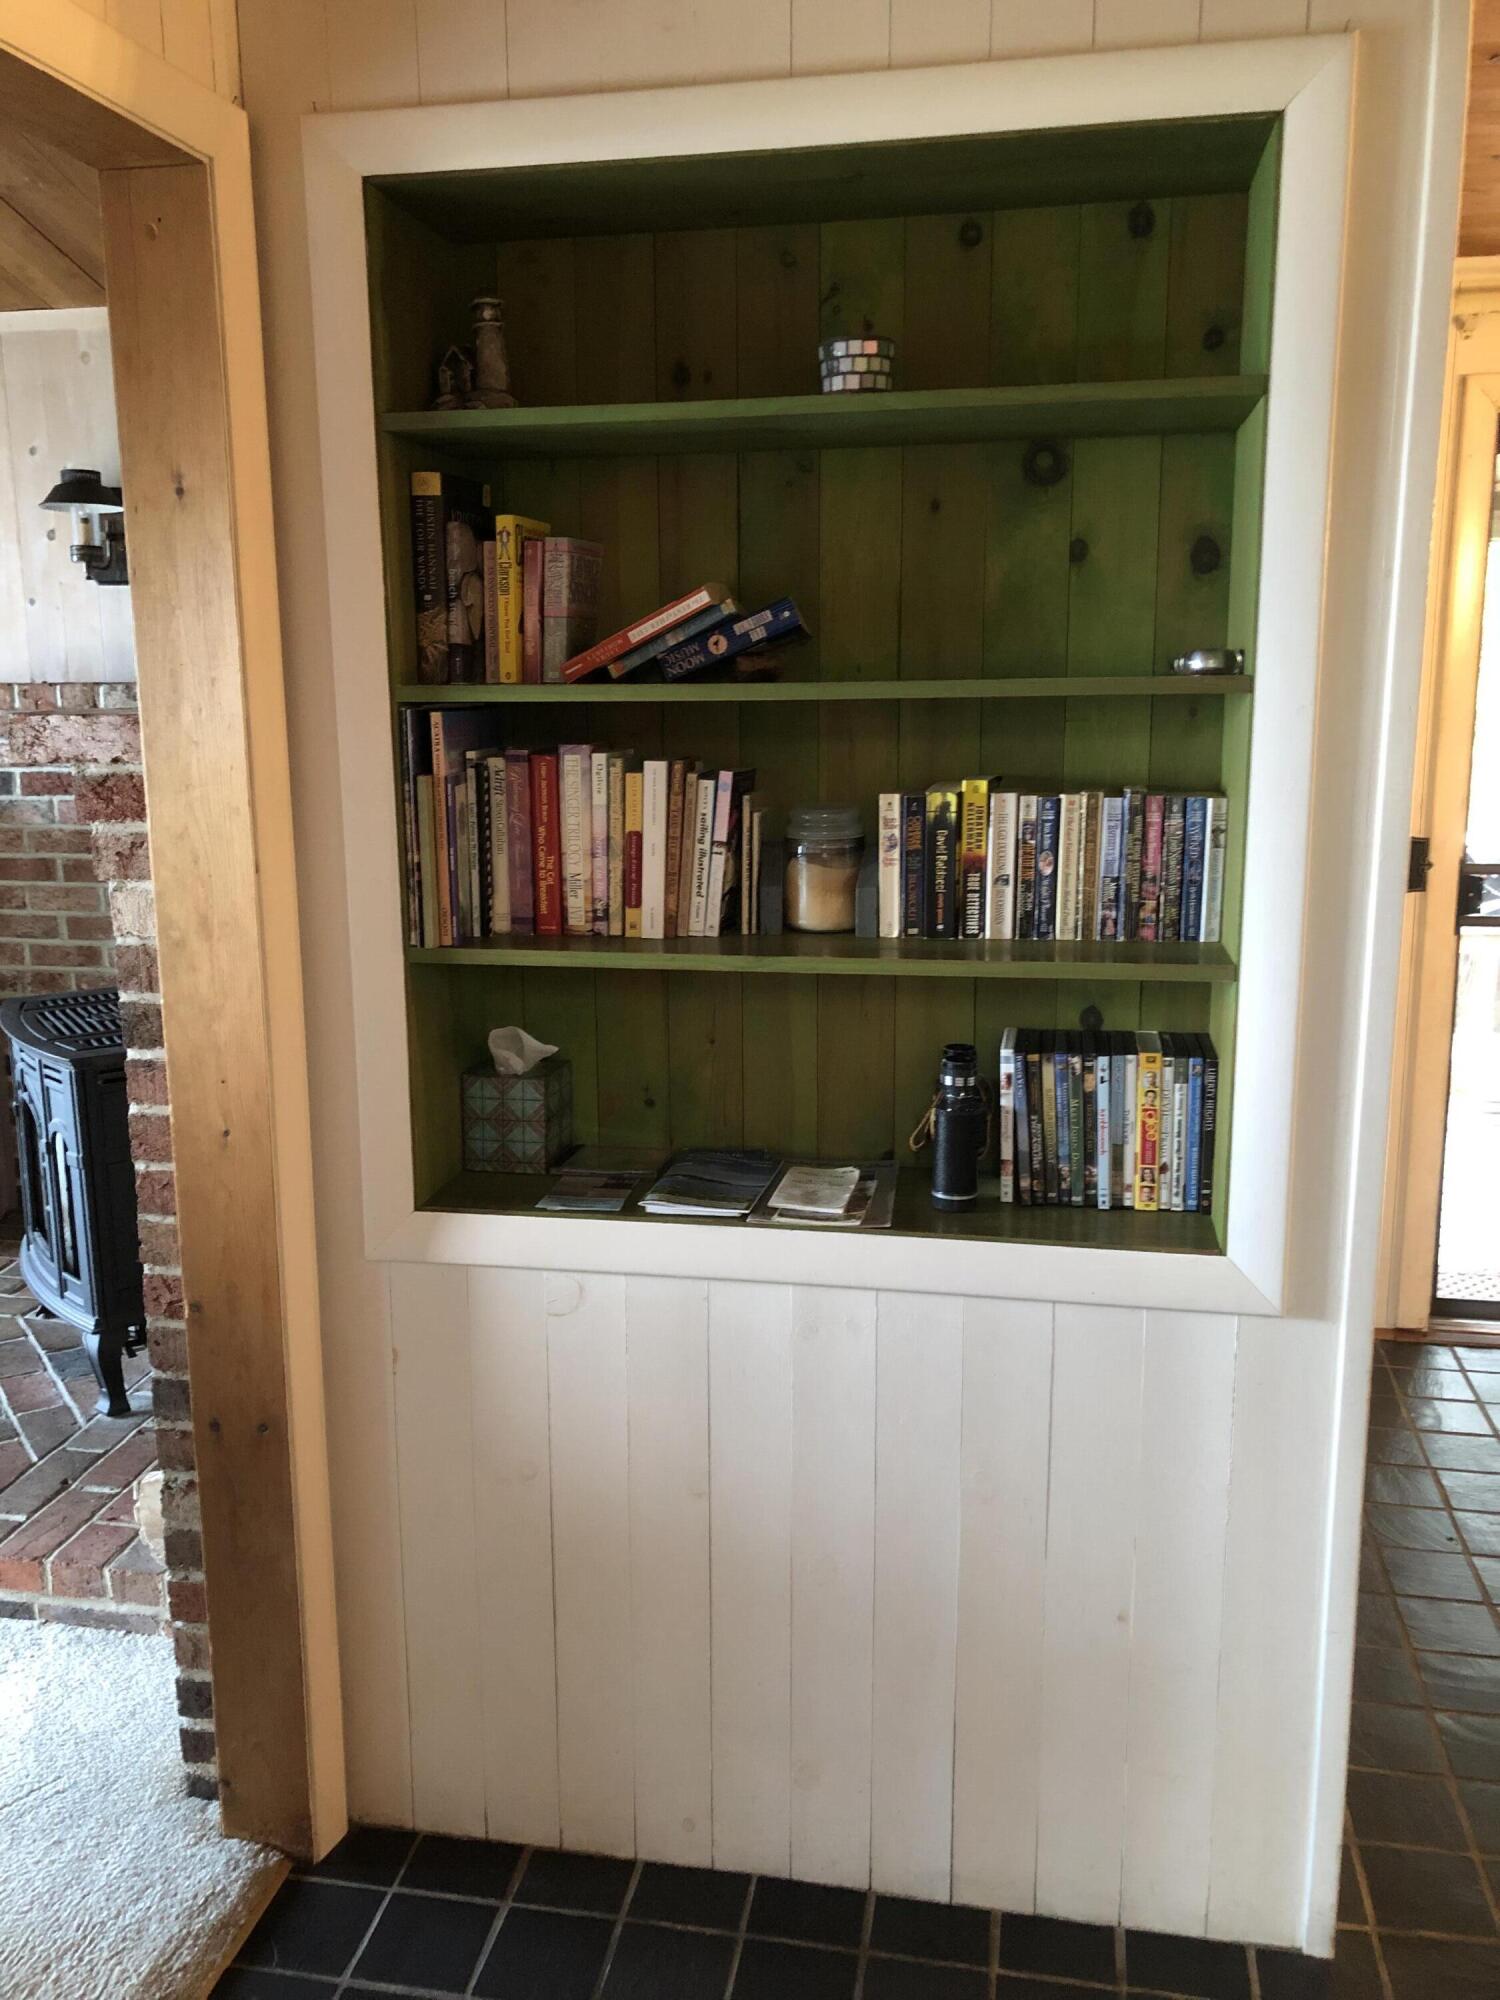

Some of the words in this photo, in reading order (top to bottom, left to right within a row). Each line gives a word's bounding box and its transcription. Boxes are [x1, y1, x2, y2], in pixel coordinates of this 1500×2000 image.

[448, 568, 459, 599] beach
[499, 561, 513, 596] Clarkson
[493, 765, 505, 796] Adrift
[566, 758, 579, 778] THE
[595, 763, 604, 794] Ogilvie
[495, 799, 505, 822] Steven
[567, 781, 580, 818] SINGER
[495, 822, 506, 855] Callahan
[538, 826, 547, 844] Who
[697, 812, 709, 845] sailing
[935, 830, 949, 854] David
[965, 802, 976, 852] KELLERMAN
[975, 806, 985, 849] JONATHAN
[538, 846, 548, 867] Came
[568, 822, 581, 866] TRILOGY
[539, 870, 548, 879] to
[547, 856, 555, 869] The
[547, 871, 555, 885] Cat
[696, 848, 708, 898] illustrated
[935, 855, 949, 893] Baldacci
[539, 881, 549, 914] Breakfast
[569, 872, 582, 898] Miller
[967, 873, 982, 891] TRUE
[966, 893, 981, 935] DETECTIVES
[1206, 1067, 1216, 1097] LIBERTY
[1204, 1100, 1215, 1132] HEIGHTS
